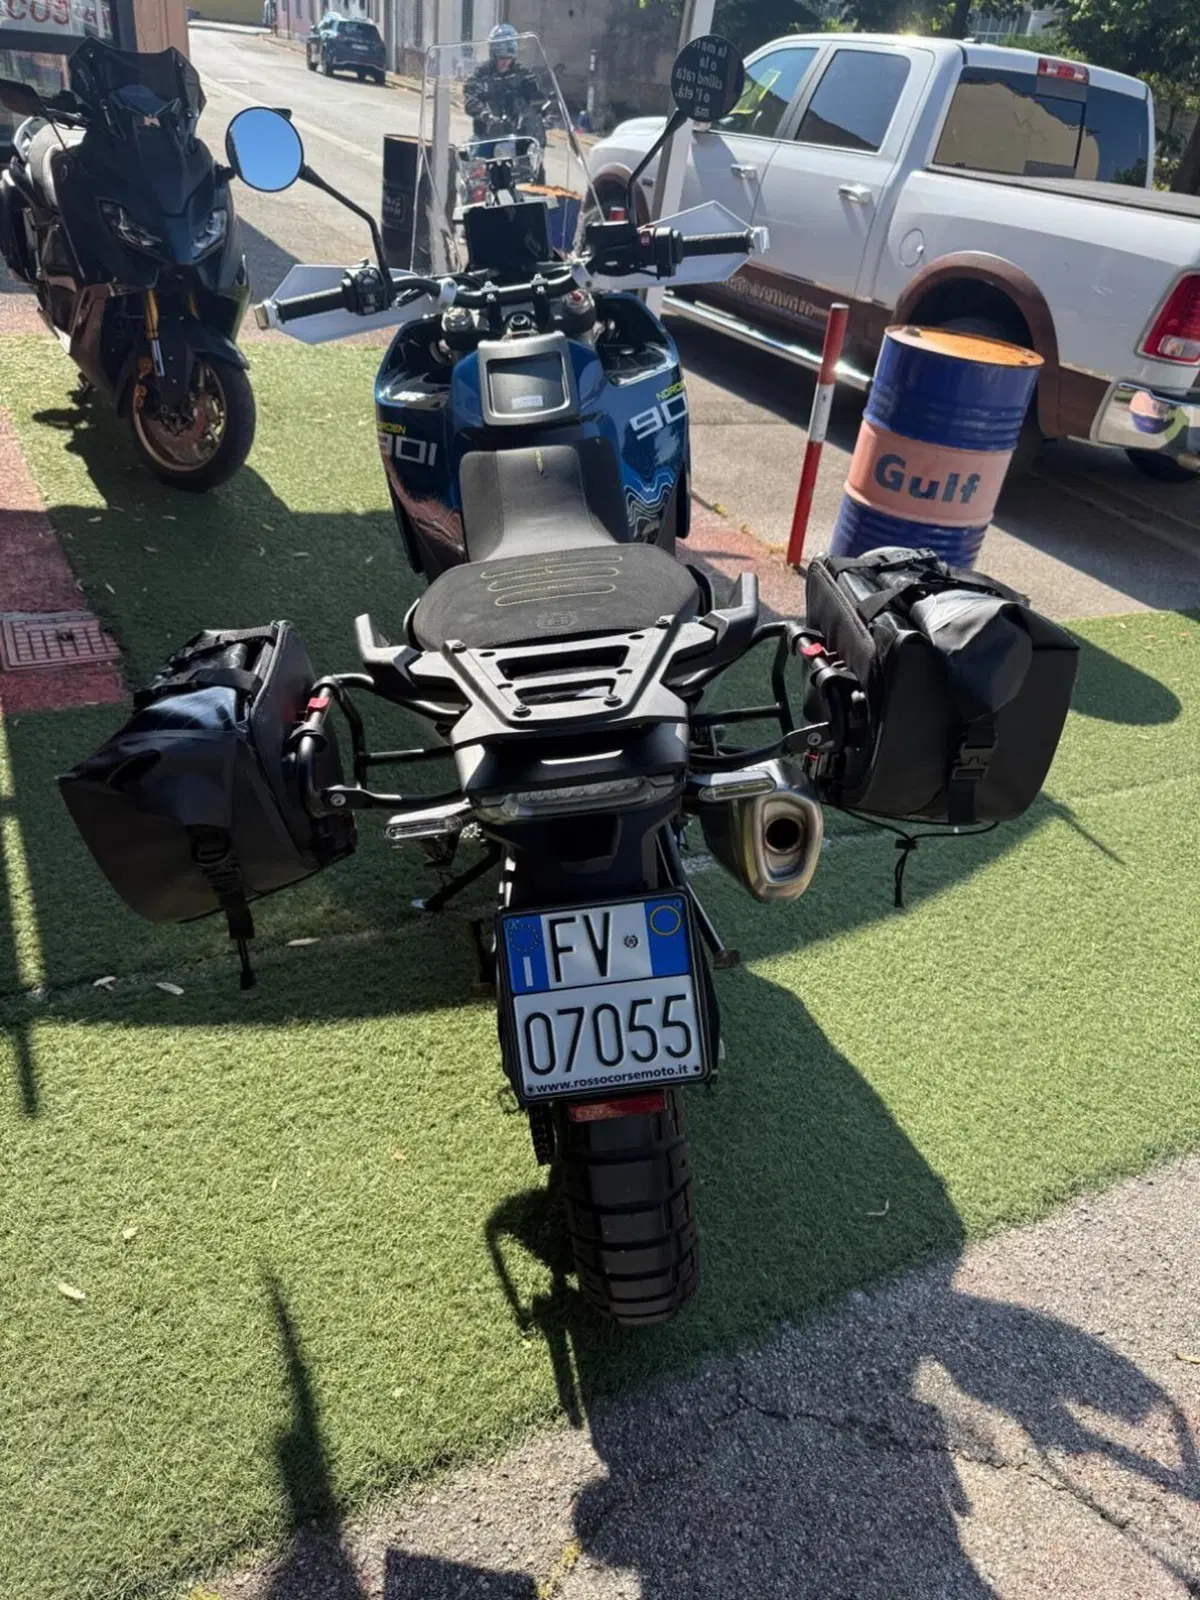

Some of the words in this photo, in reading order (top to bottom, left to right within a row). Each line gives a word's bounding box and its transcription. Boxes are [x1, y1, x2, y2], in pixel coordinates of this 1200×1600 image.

[874, 453, 981, 504] Gulf
[548, 911, 610, 983] FV
[524, 993, 692, 1076] 07055
[536, 1063, 688, 1093] www.rossocorsemoto.it
